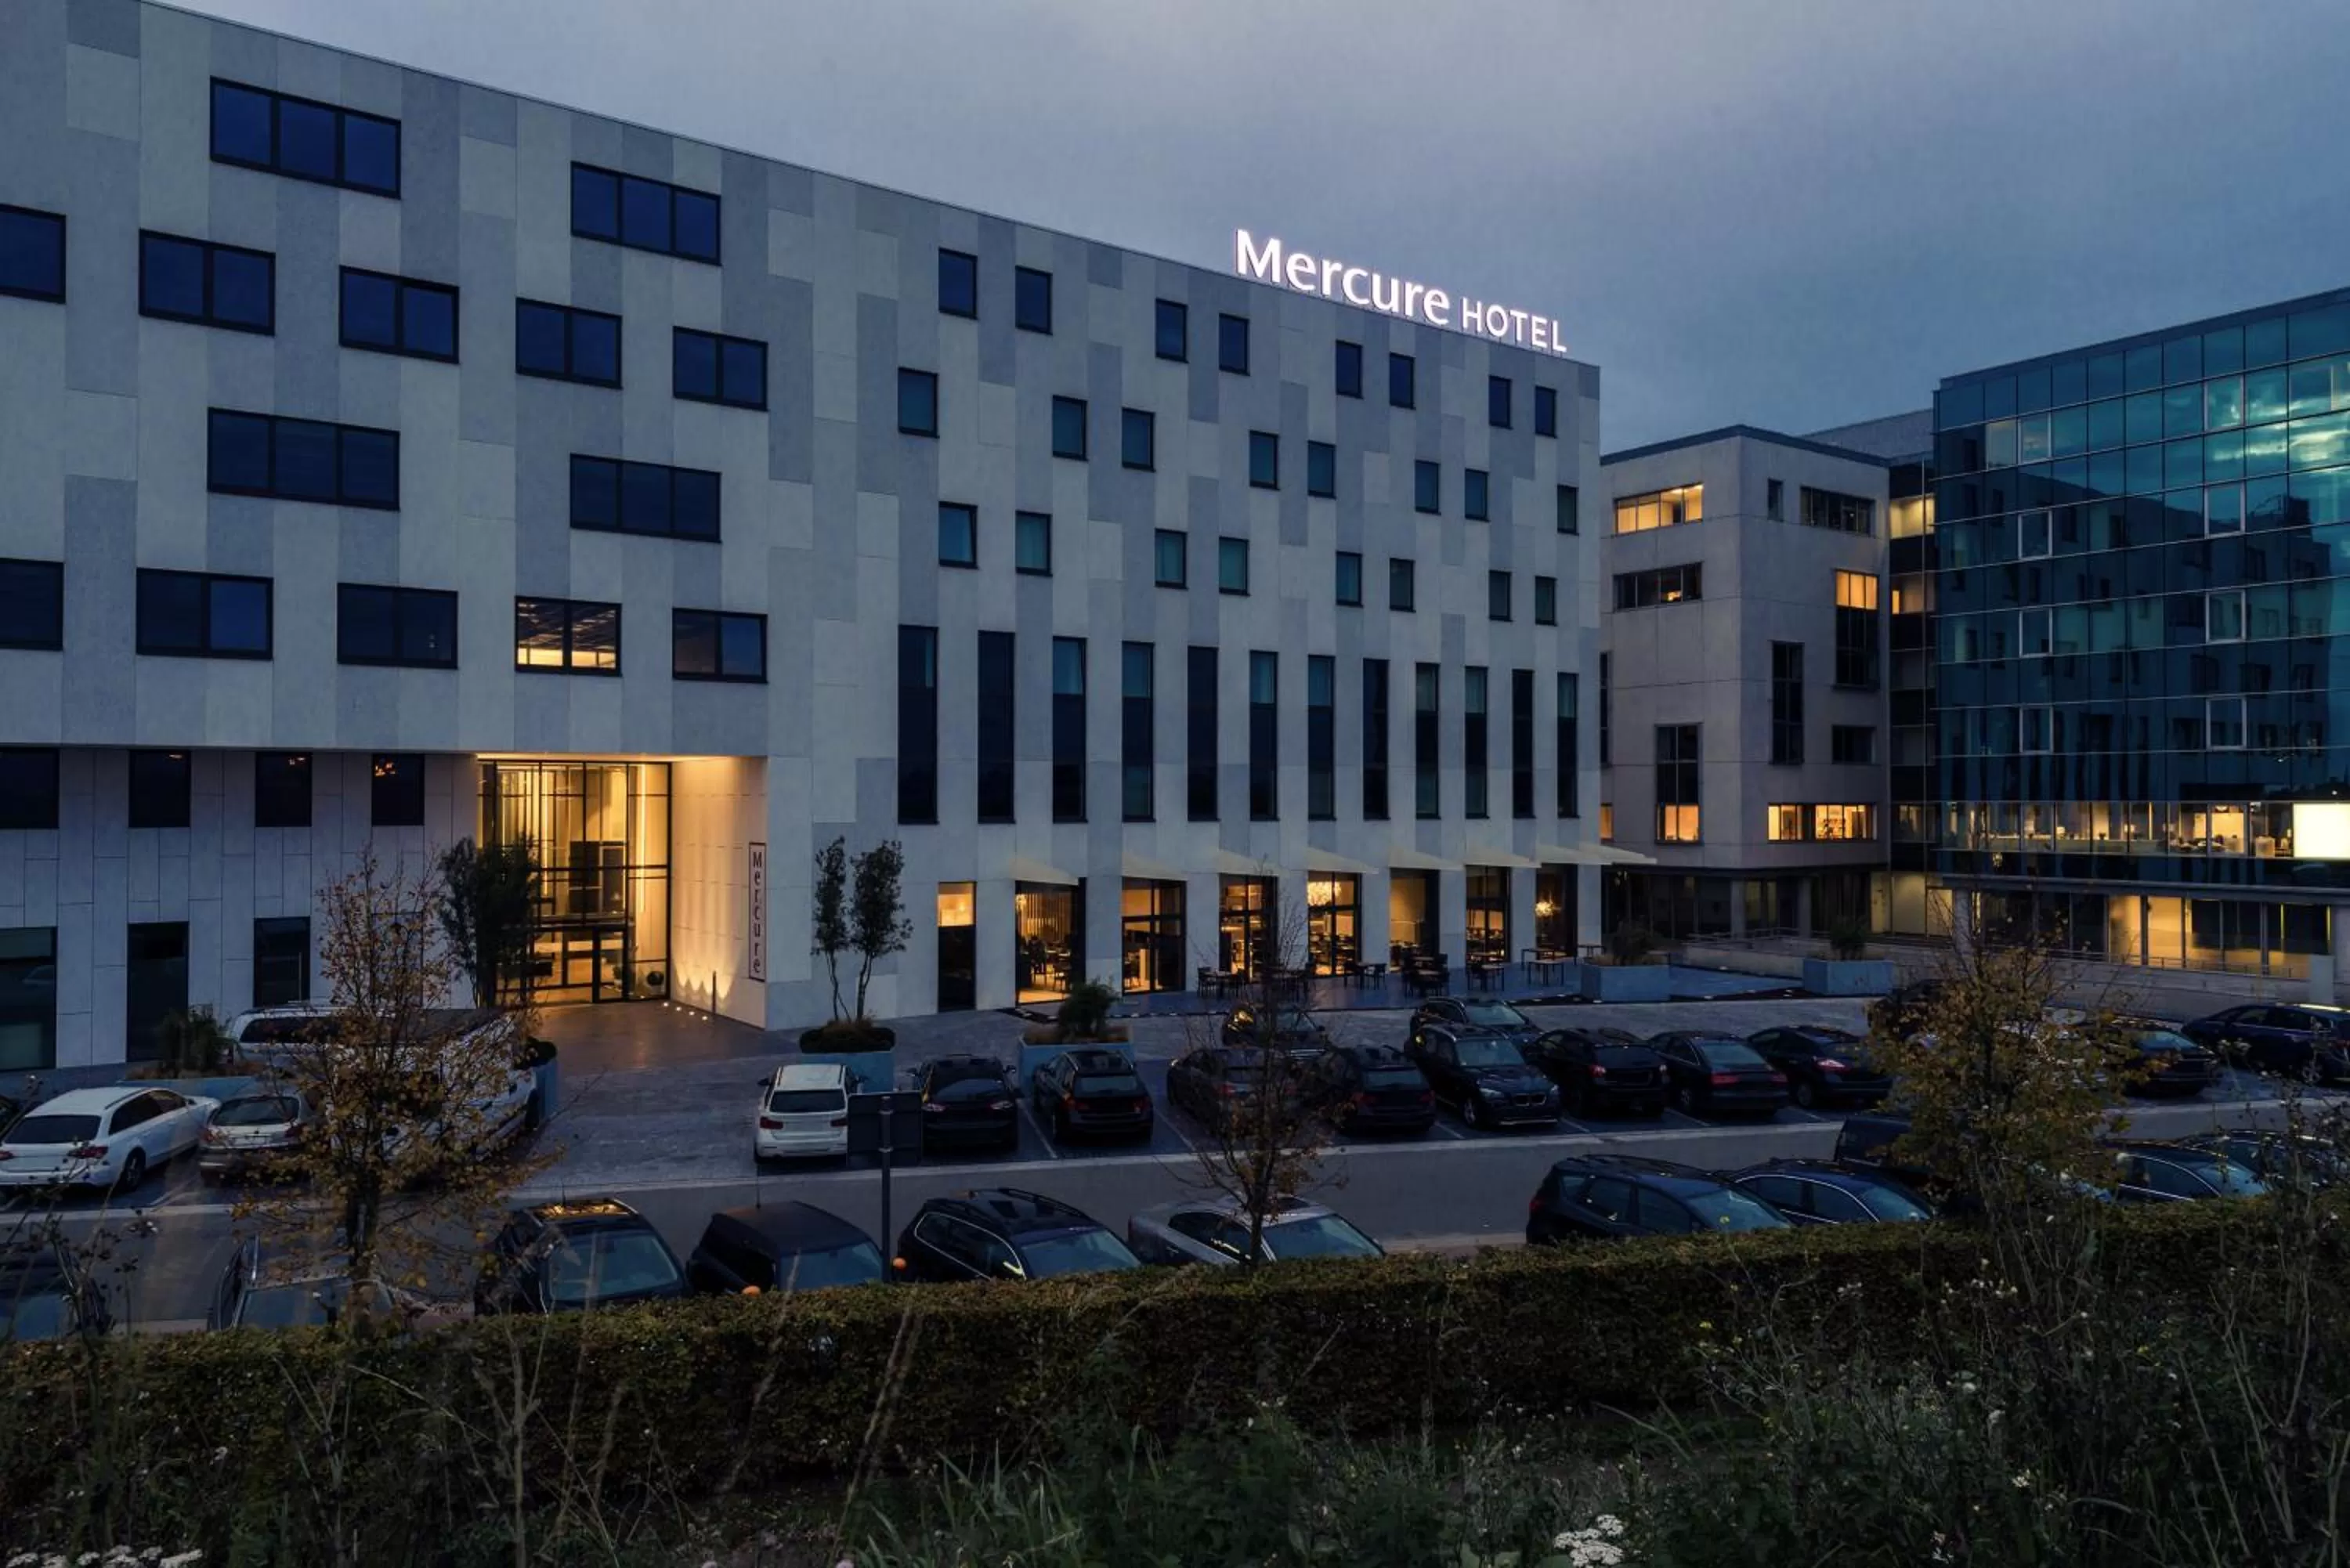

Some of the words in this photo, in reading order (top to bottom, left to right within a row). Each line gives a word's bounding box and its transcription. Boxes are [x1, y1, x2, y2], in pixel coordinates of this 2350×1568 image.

[1235, 229, 1451, 325] Mercure
[1462, 297, 1567, 352] HOTEL
[752, 851, 762, 974] Mercure
